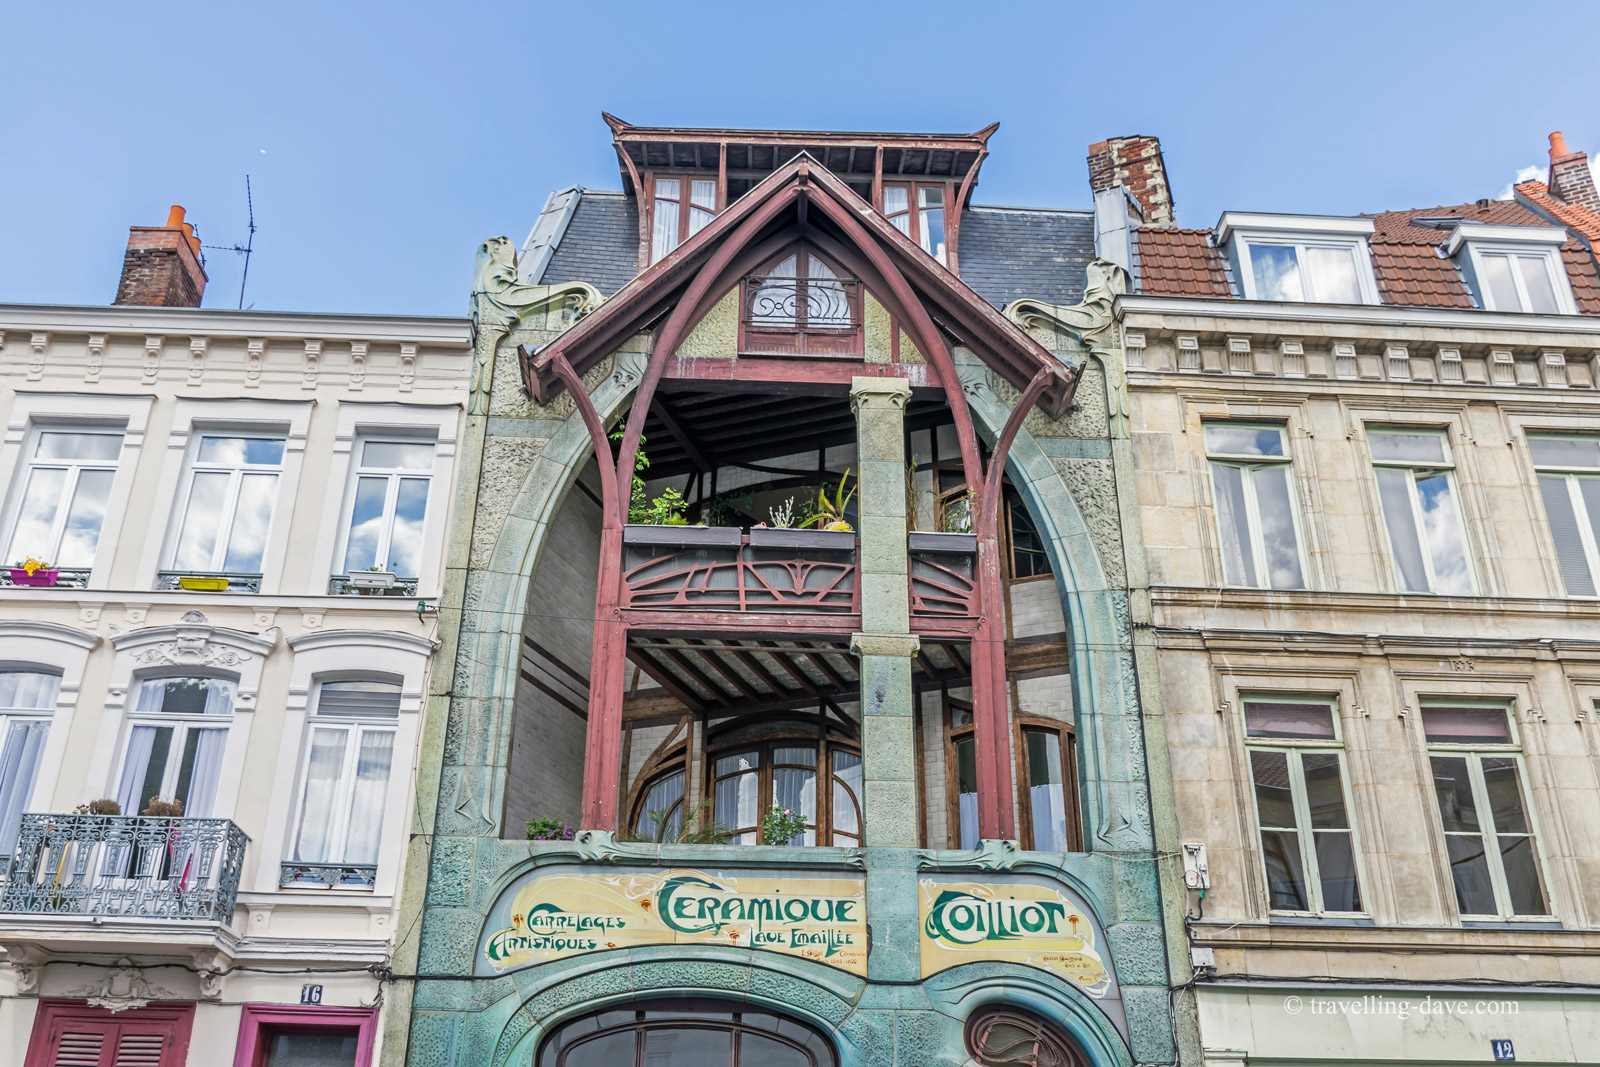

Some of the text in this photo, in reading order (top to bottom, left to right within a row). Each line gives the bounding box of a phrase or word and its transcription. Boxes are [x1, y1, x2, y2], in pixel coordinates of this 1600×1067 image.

[925, 890, 1065, 944] COILLIOT
[303, 985, 320, 1002] 16
[1497, 1041, 1514, 1058] 12
